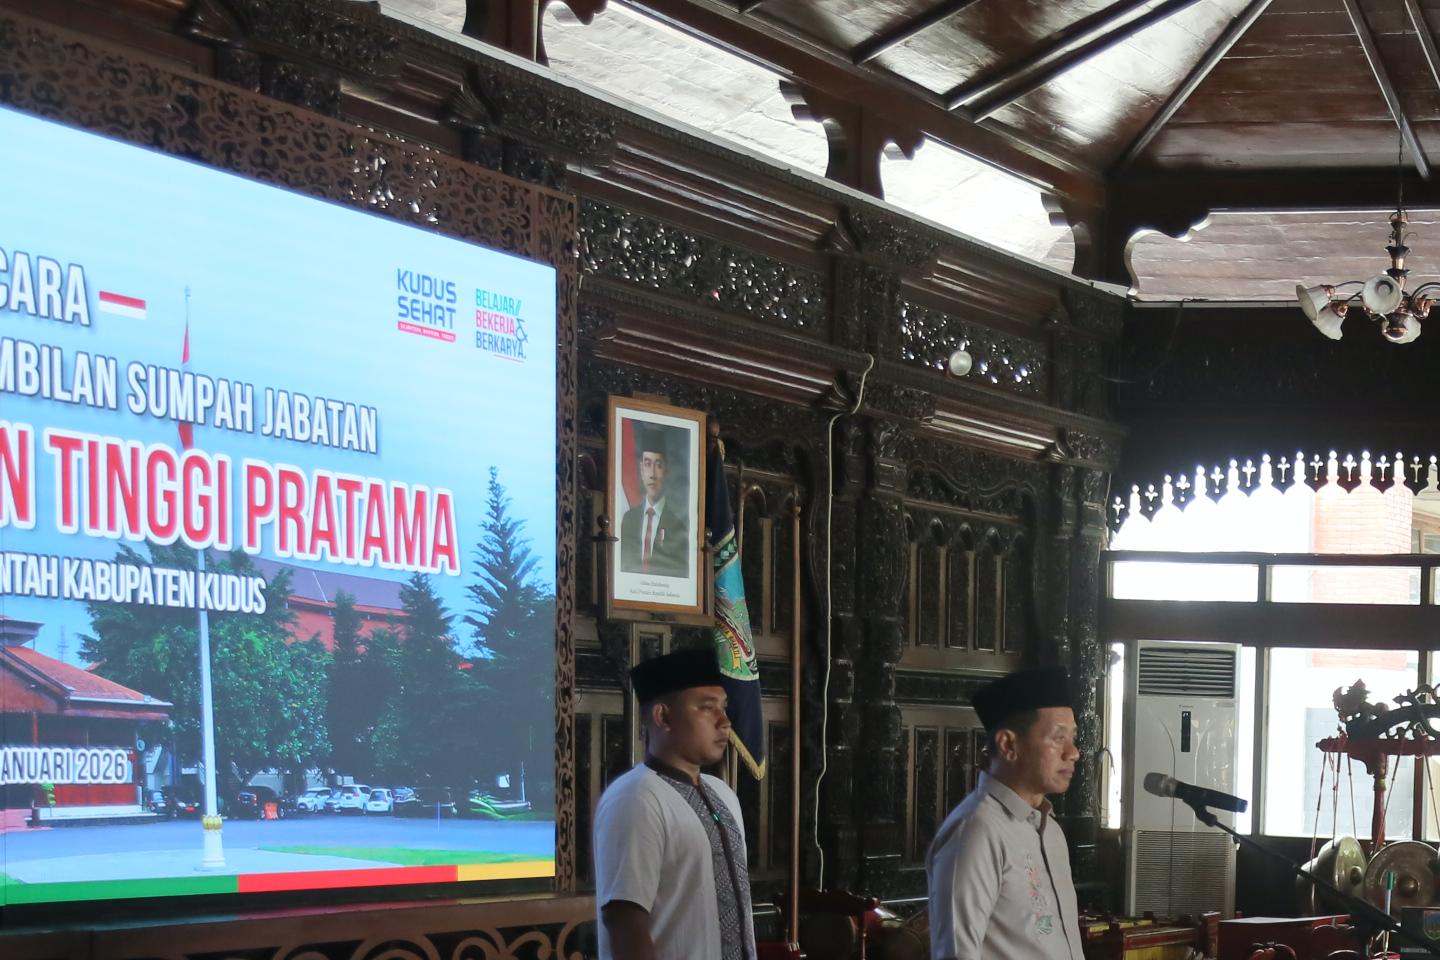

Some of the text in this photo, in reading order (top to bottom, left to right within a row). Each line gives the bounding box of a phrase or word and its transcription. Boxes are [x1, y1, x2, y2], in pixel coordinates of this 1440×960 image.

[397, 268, 457, 304] KUDUS
[398, 296, 457, 329] SEHAT
[475, 309, 516, 337] BEKERJA
[127, 361, 254, 433] SUMPAH
[261, 387, 378, 454] JABATAN
[47, 431, 230, 548] TINGGI
[244, 462, 459, 574] PRATAMA
[0, 552, 267, 614] NTAH KABUPATEN KUDUS
[0, 749, 126, 783] ANUARI 2026
